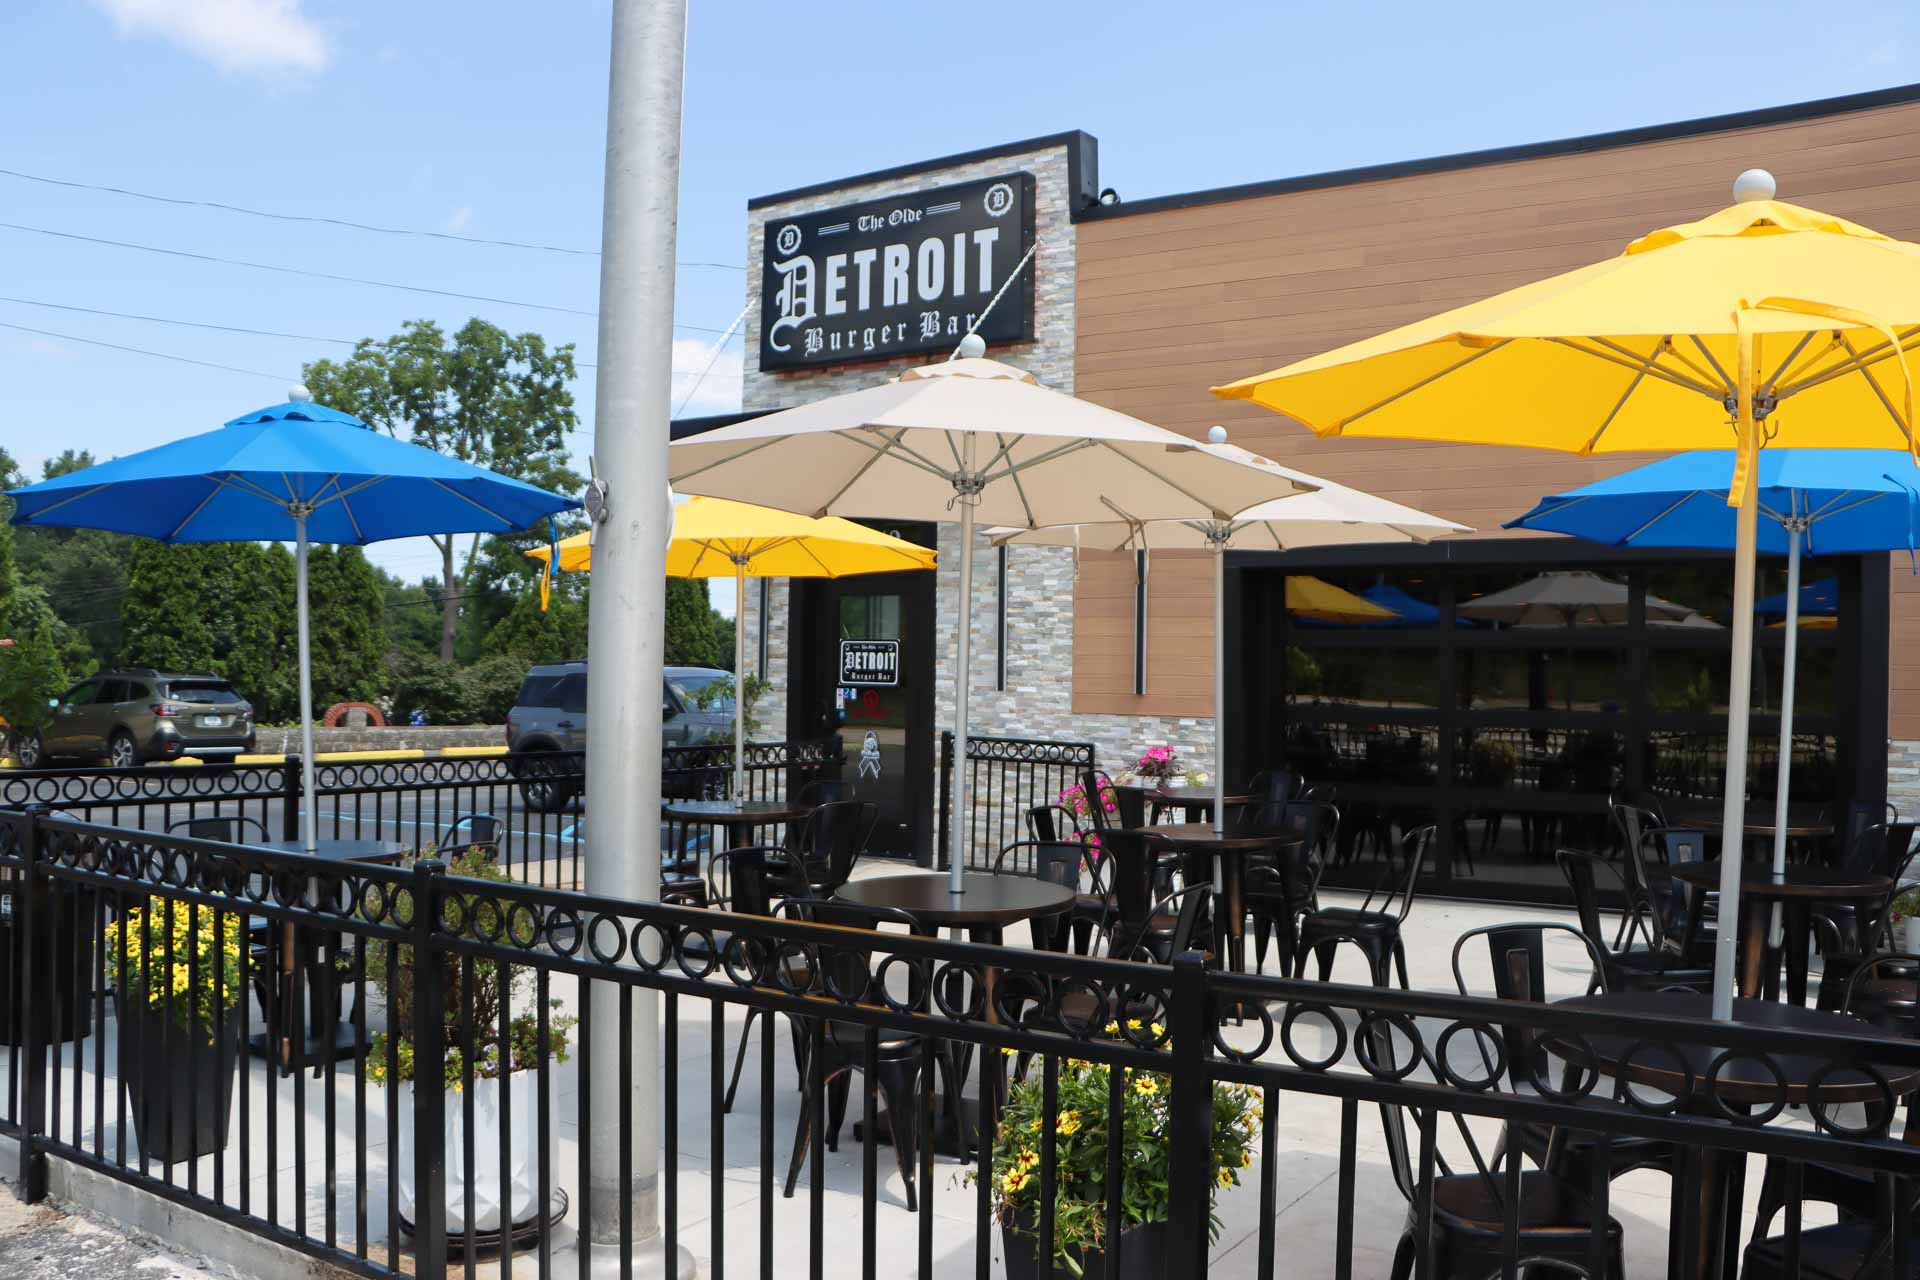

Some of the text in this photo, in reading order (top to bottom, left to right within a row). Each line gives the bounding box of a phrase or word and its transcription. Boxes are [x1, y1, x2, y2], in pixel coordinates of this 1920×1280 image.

[857, 207, 923, 232] The Olde
[769, 226, 1000, 353] DETROIT
[803, 310, 977, 358] Burger Bar
[844, 651, 896, 674] DETROIT
